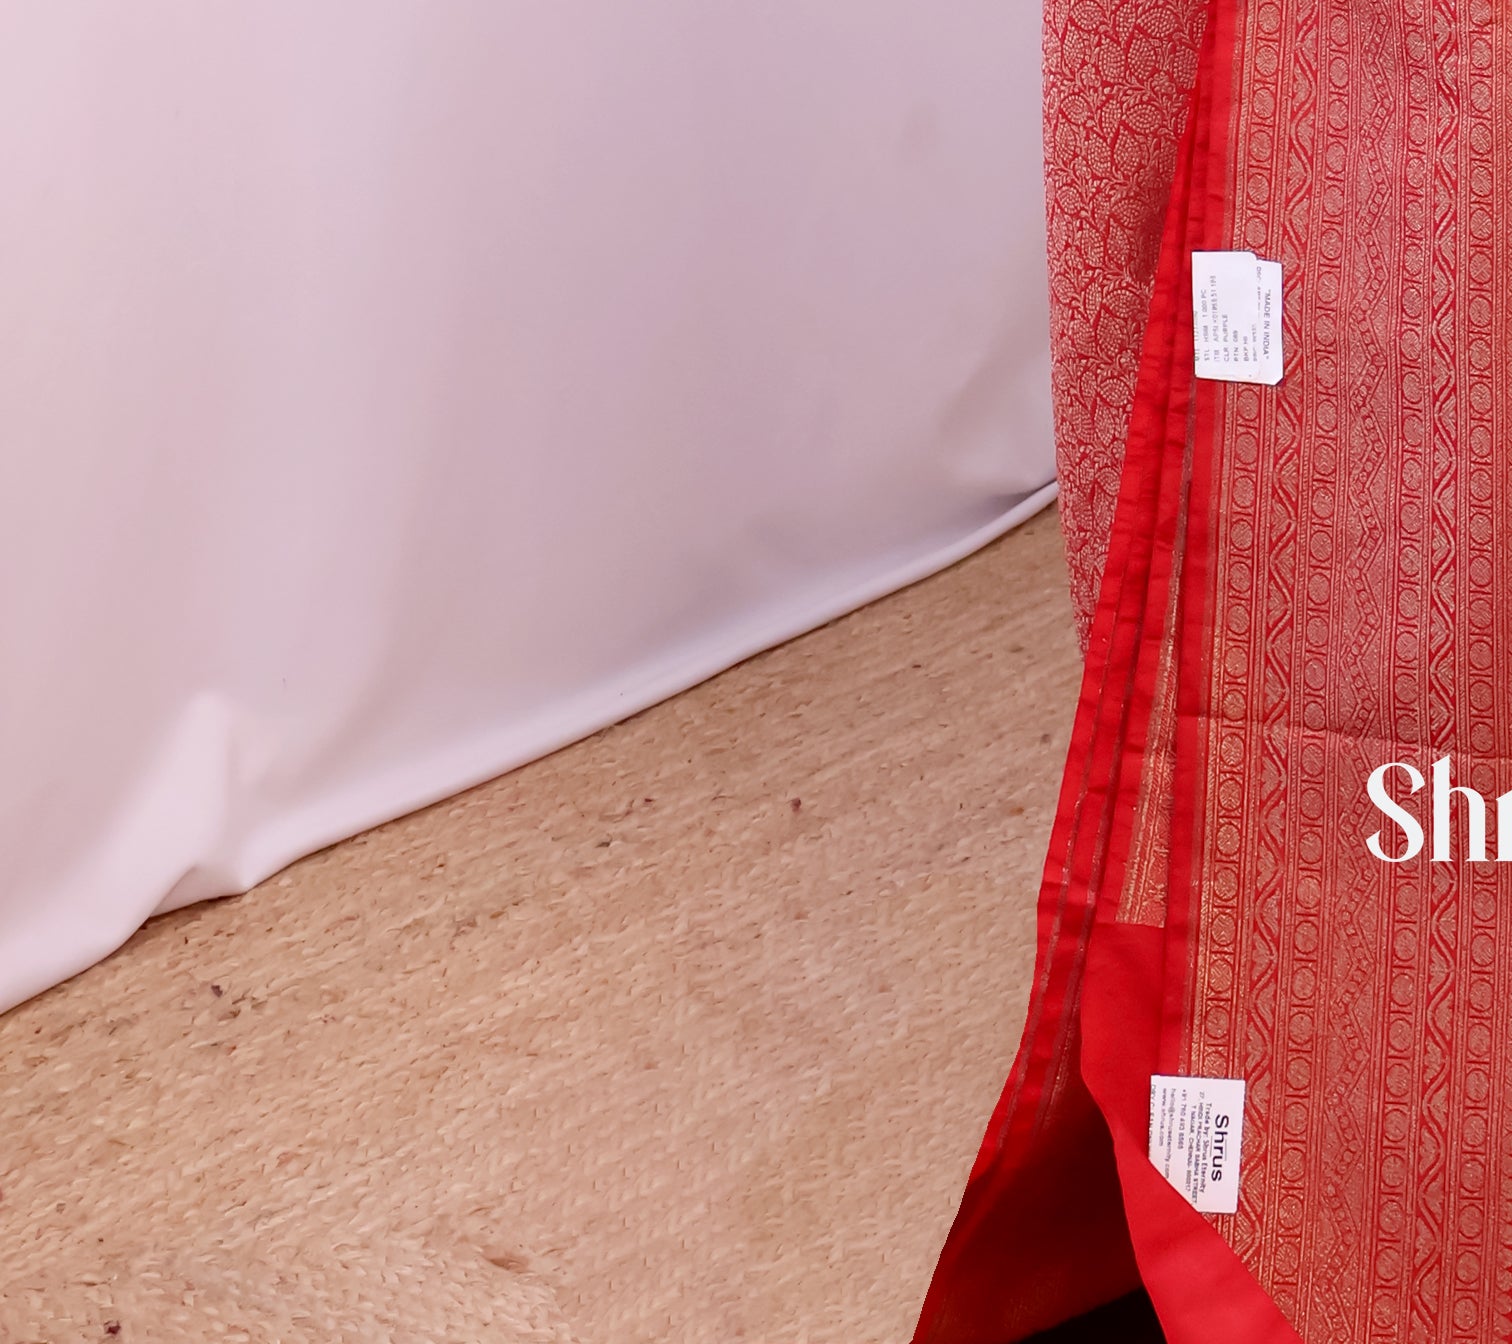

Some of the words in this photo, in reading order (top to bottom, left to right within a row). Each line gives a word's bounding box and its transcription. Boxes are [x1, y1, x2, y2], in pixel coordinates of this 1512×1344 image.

[1264, 321, 1270, 329] IN
[1211, 1114, 1229, 1182] Shrus
[1199, 1163, 1208, 1192] Eternity
